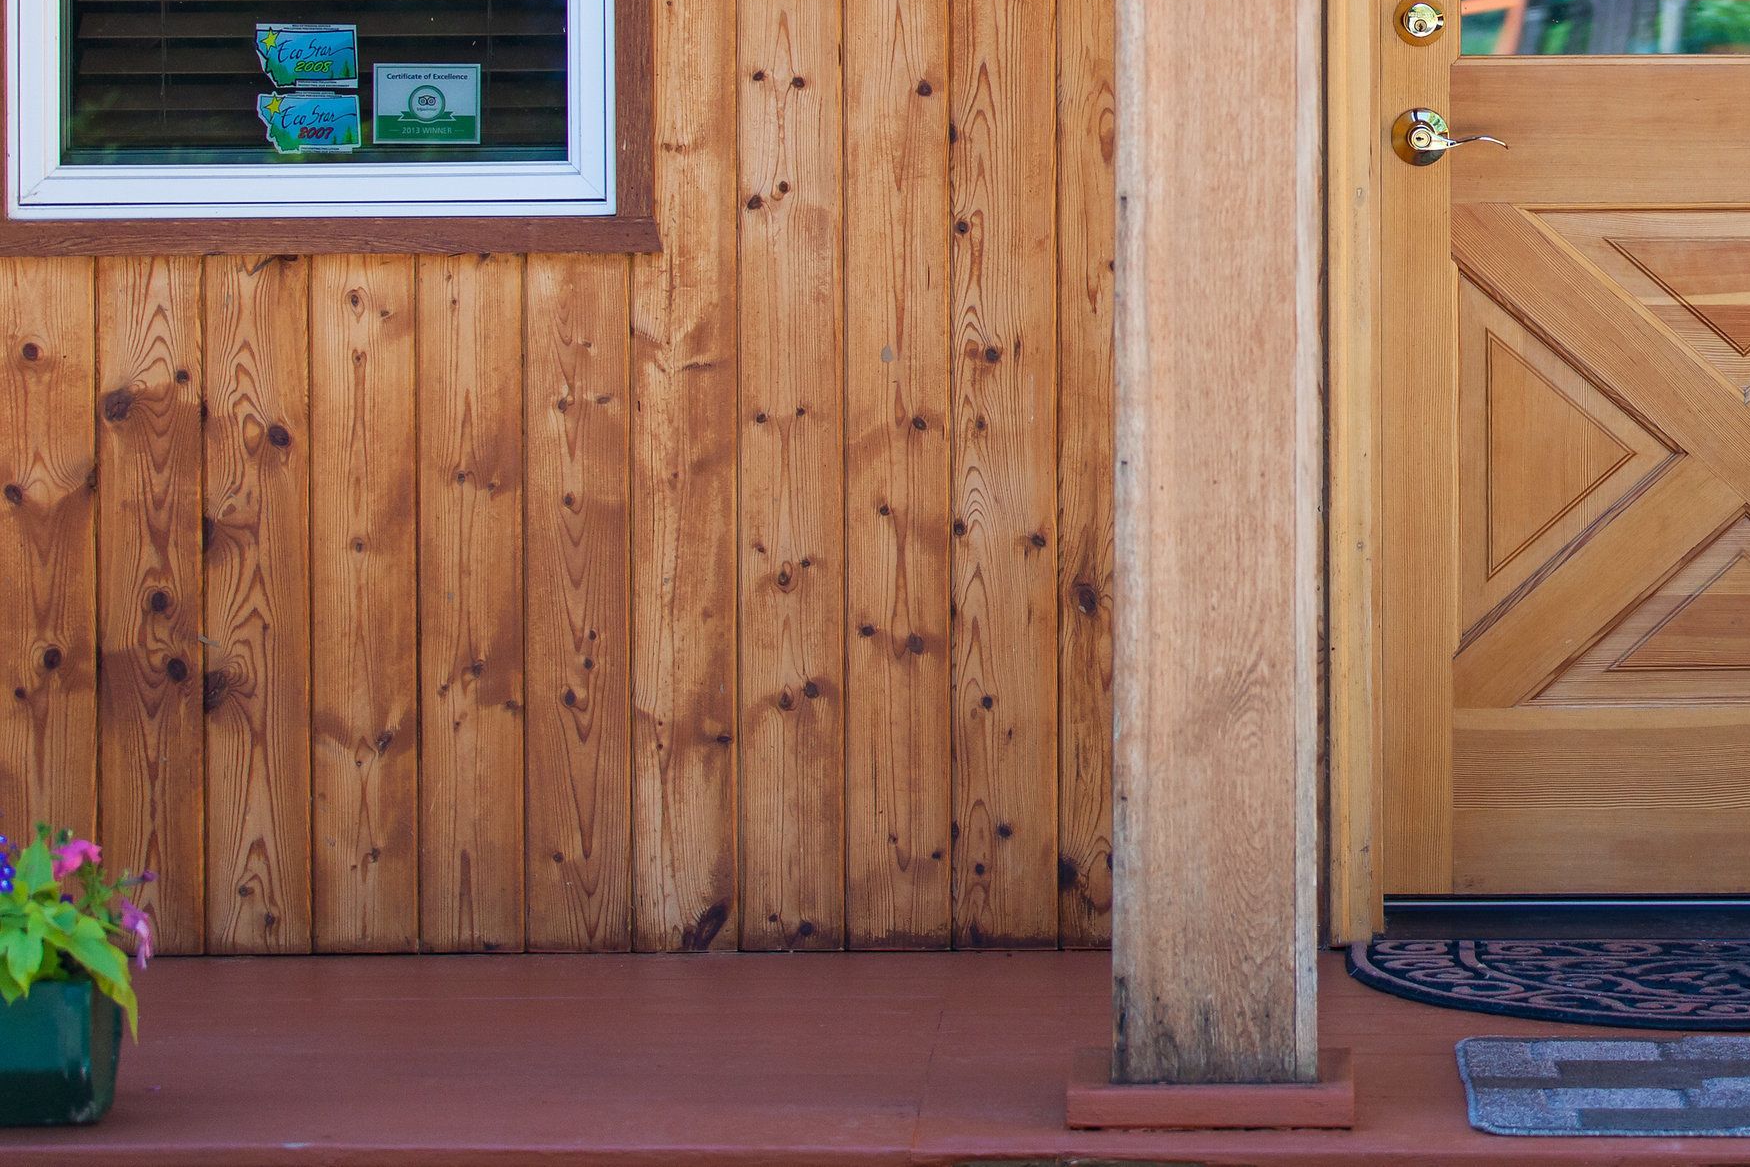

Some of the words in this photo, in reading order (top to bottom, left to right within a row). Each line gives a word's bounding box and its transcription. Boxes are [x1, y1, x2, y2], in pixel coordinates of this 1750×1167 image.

[277, 39, 303, 63] Eco
[303, 38, 349, 60] Star
[294, 60, 333, 73] 2008
[386, 72, 422, 80] Certificate
[423, 72, 432, 80] of
[432, 72, 468, 80] Excellence
[281, 105, 307, 129] Eco
[307, 104, 352, 126] Star
[297, 126, 334, 140] 2007
[401, 126, 420, 135] 2013
[422, 126, 453, 135] WINNER
